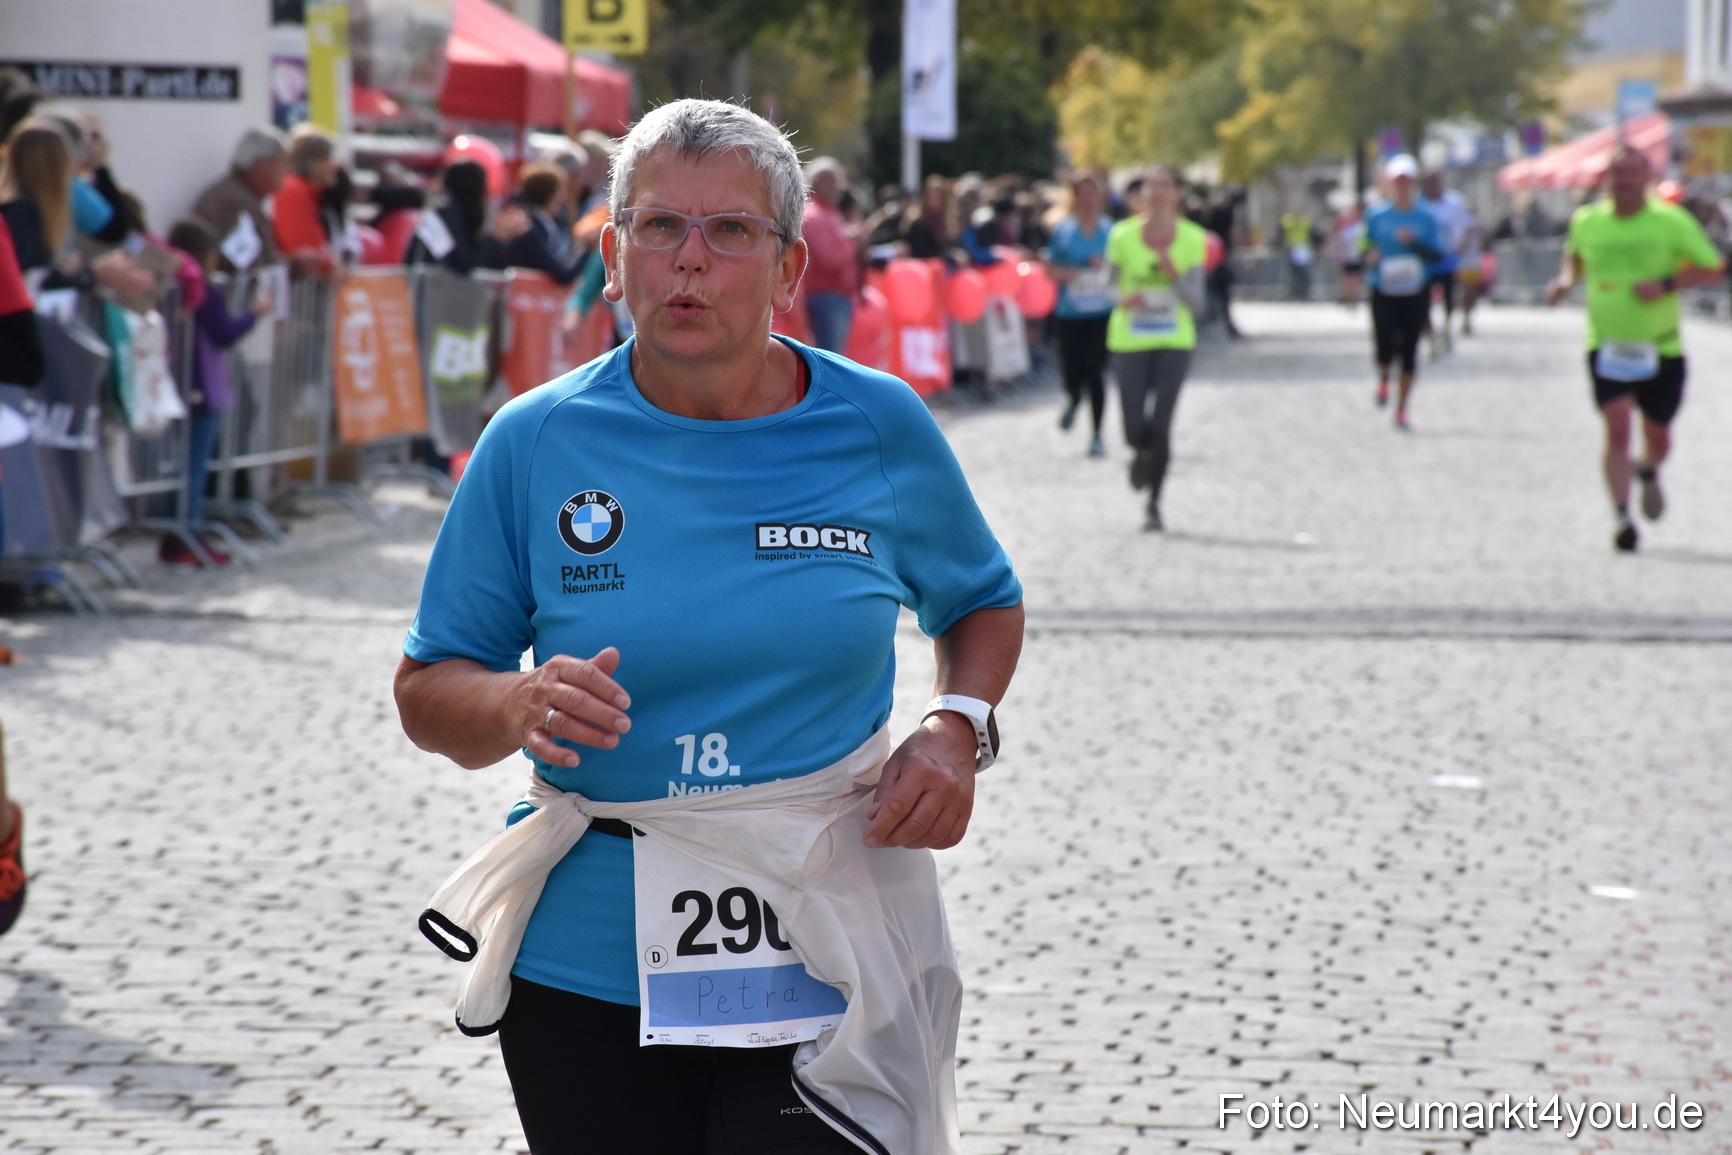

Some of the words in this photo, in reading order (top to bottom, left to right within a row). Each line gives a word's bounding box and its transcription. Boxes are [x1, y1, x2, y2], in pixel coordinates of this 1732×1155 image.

[564, 492, 619, 515] BMW
[757, 524, 873, 557] BOCK
[755, 552, 796, 561] inspired
[799, 551, 811, 560] by
[561, 563, 626, 582] PARTL
[562, 579, 625, 595] Neumarkt
[674, 732, 741, 777] 18.
[698, 975, 799, 1016] Petra
